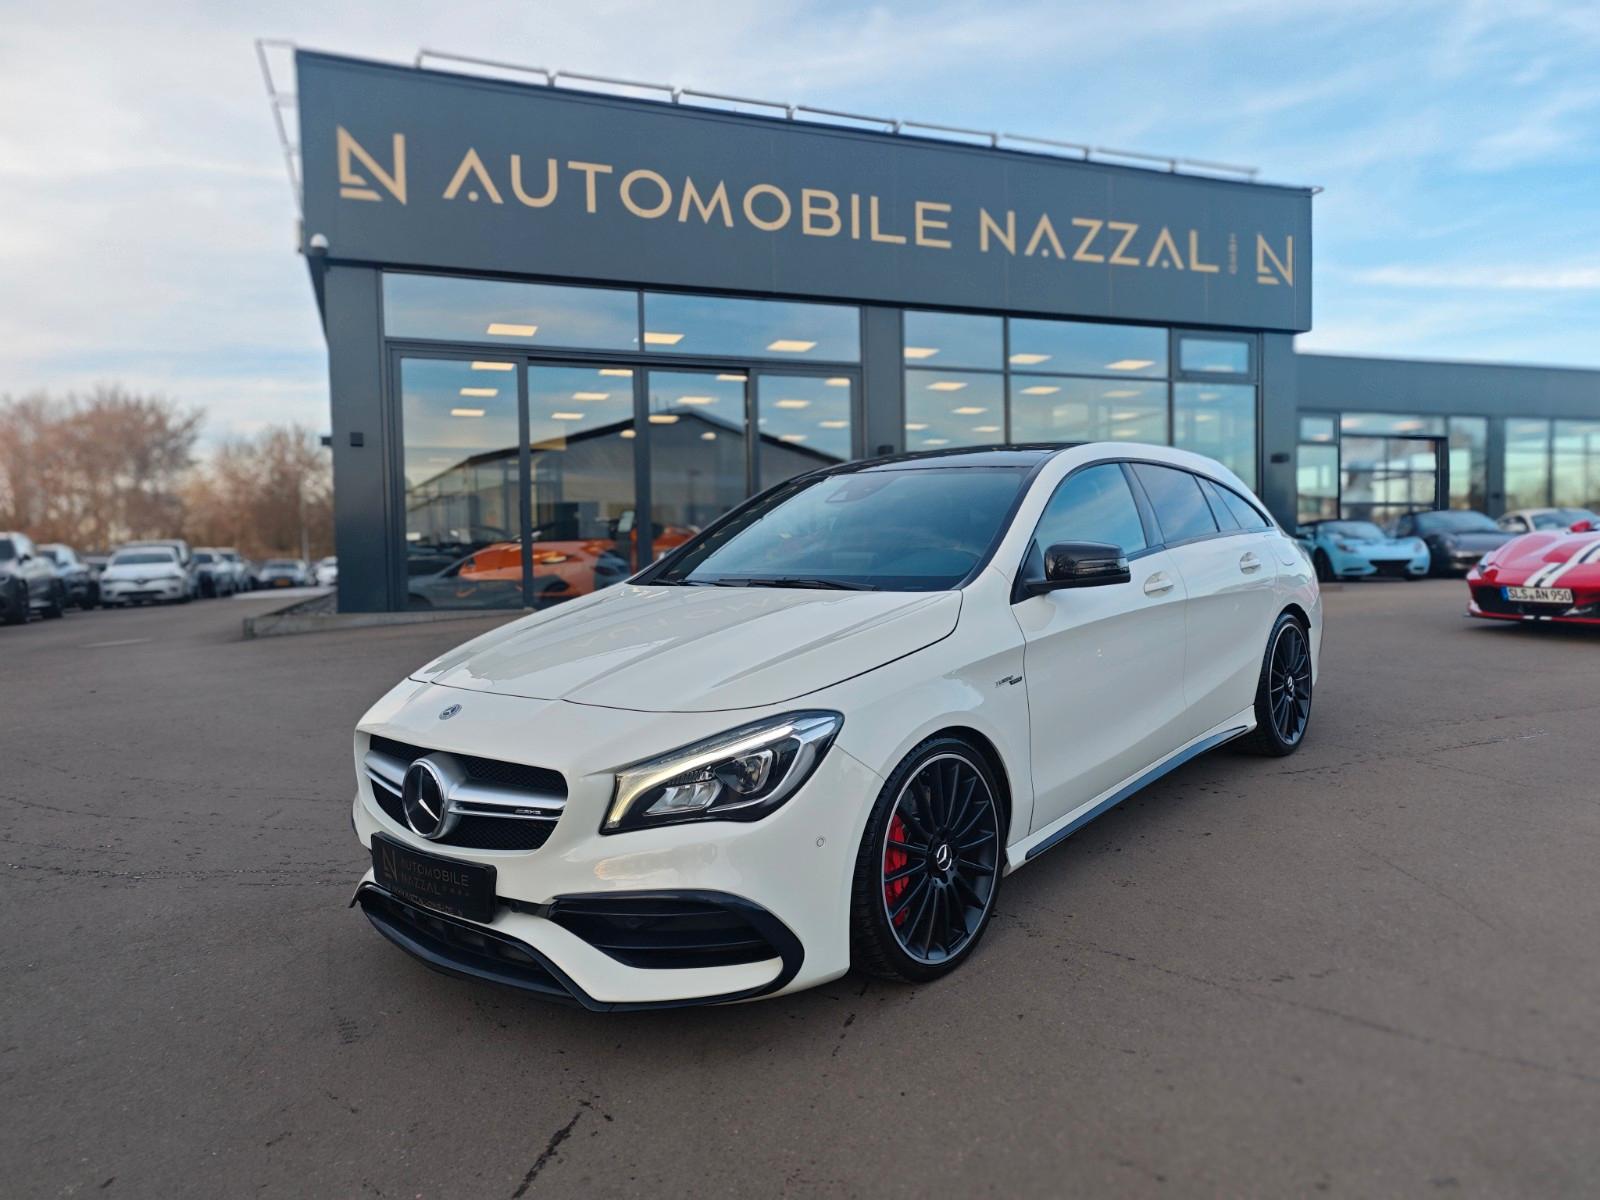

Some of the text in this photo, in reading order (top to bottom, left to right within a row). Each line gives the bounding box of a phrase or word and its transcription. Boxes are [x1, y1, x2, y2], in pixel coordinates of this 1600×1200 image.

[443, 146, 1220, 274] AUTOMOBILE NAZZAL
[1508, 588, 1572, 602] SLS AN 950
